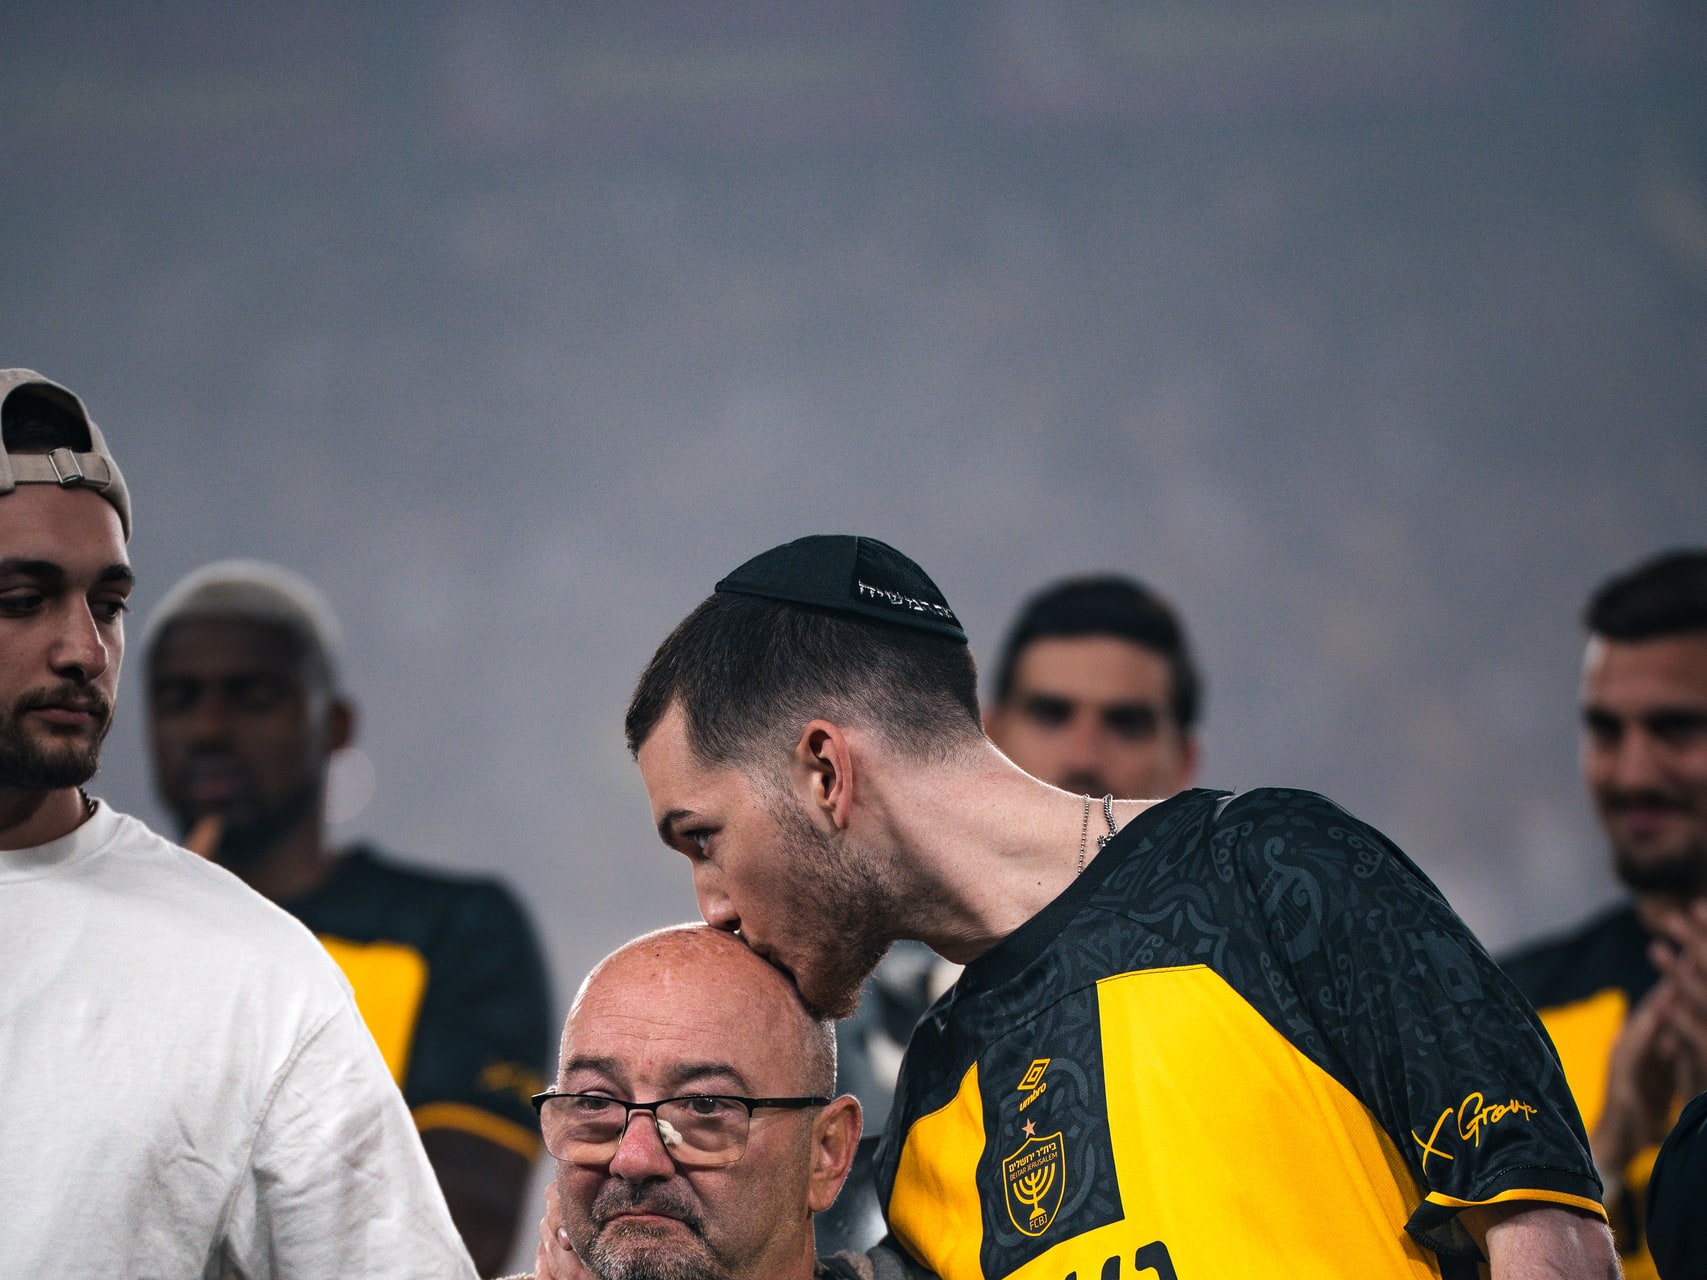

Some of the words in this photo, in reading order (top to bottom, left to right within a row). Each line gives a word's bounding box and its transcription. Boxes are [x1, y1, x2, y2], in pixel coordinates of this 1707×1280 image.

[1019, 1082, 1047, 1112] umbro
[1411, 1107, 1455, 1176] X
[1008, 1151, 1036, 1173] ירושלים
[1009, 1165, 1028, 1181] BEITAR
[1026, 1152, 1059, 1175] JERUSALEM
[1029, 1213, 1049, 1231] FCBJ
